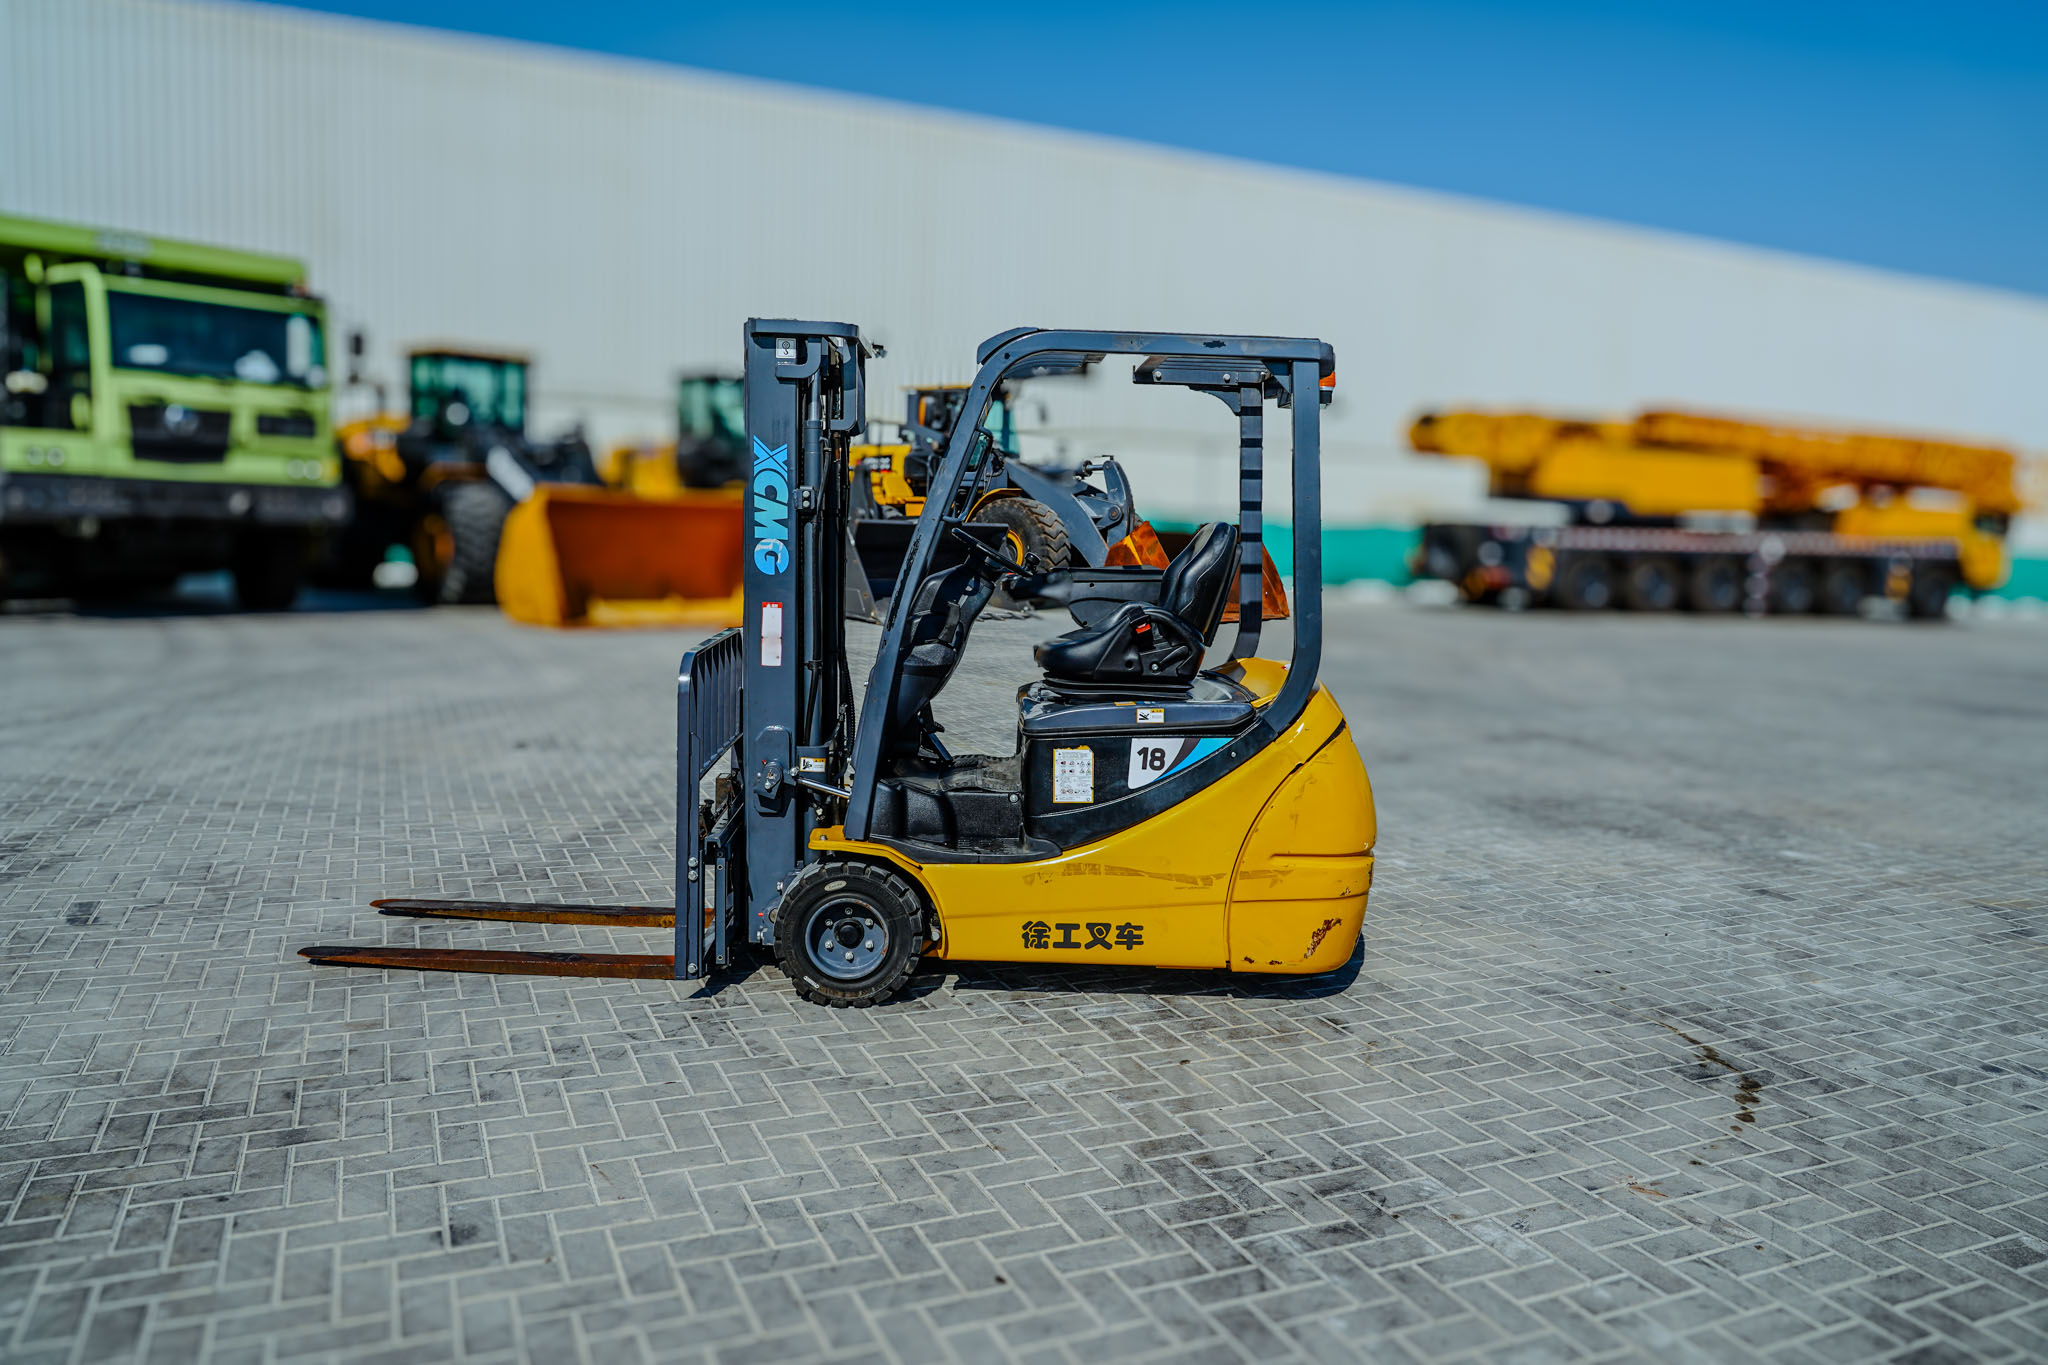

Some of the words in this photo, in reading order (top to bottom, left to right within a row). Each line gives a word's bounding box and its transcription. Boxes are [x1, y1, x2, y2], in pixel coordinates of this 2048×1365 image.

[753, 434, 789, 575] XCMG
[1137, 746, 1166, 771] 18
[1021, 920, 1144, 950] 徐工叉车
